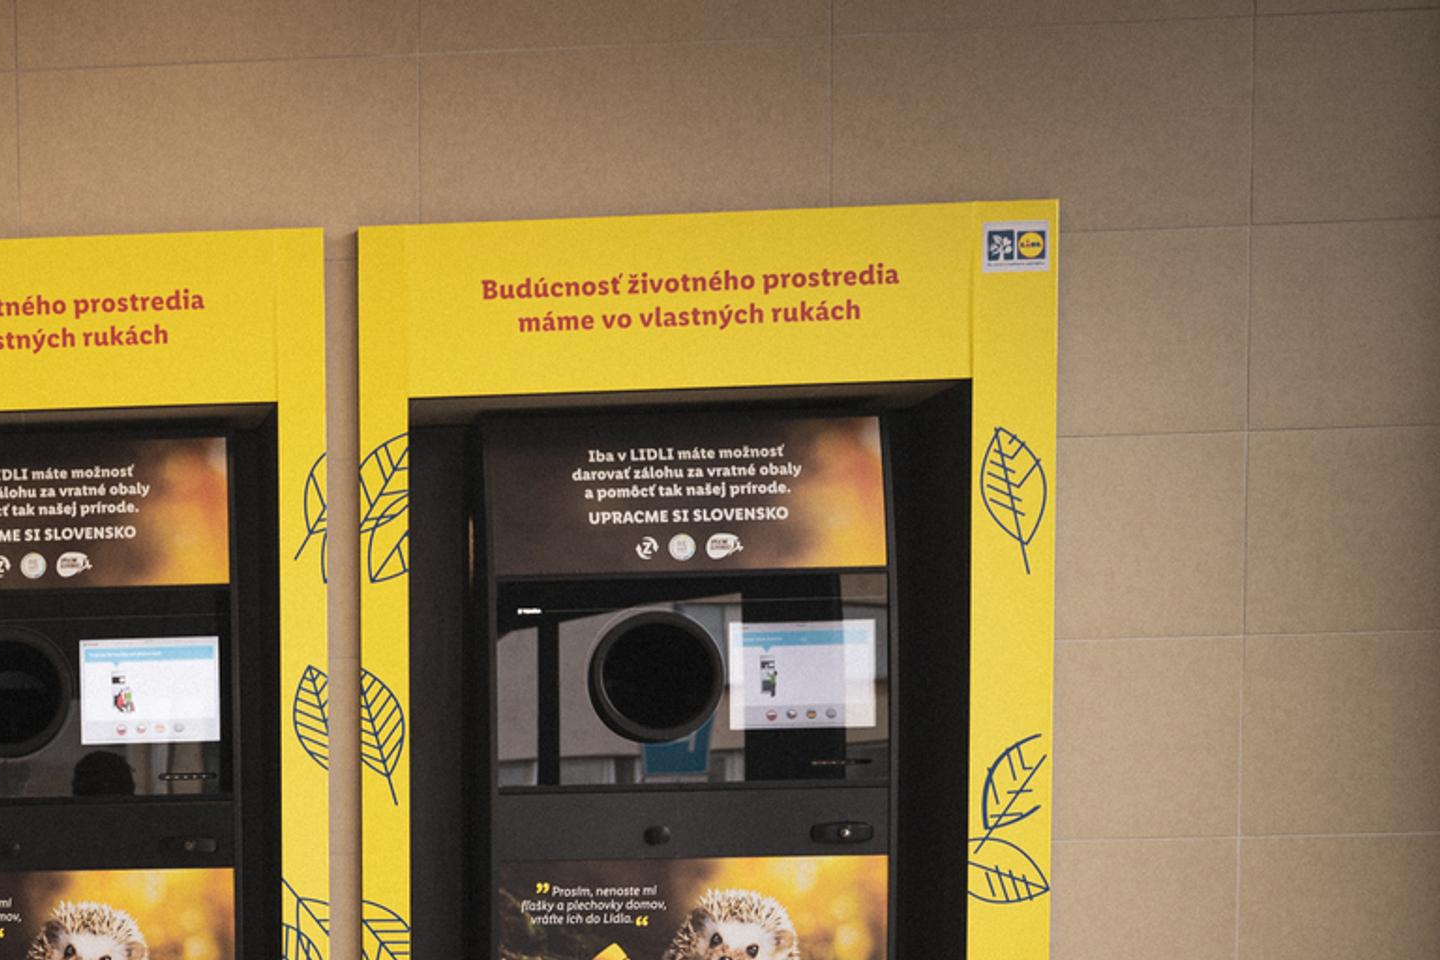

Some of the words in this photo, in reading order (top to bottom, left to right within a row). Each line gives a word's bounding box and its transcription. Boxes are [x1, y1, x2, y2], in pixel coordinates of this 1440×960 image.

[481, 273, 623, 300] Budúcnosť
[628, 270, 755, 295] životného
[763, 262, 900, 295] prostredia
[73, 288, 205, 320] prostredia
[518, 311, 594, 333] máme
[602, 313, 632, 329] vo
[640, 303, 764, 330] vlastných
[772, 299, 860, 323] rukách
[83, 323, 168, 347] rukách
[588, 450, 614, 463] Iba
[618, 453, 628, 462] v
[629, 448, 674, 461] LIDLI
[677, 446, 715, 460] máte
[719, 444, 785, 459] možnosť
[31, 467, 68, 480] máte
[71, 464, 135, 479] možnosť
[572, 466, 631, 481] darovať
[633, 465, 683, 479] zálohu
[687, 468, 704, 478] za
[707, 464, 756, 477] vratné
[759, 462, 802, 478] obaly
[39, 487, 56, 498] za
[59, 484, 106, 497] vratné
[109, 482, 150, 498] obaly
[584, 489, 594, 499] a
[596, 484, 656, 501] pomôcť
[659, 484, 683, 497] tak
[686, 482, 726, 498] našej
[729, 481, 791, 498] prírode.
[12, 503, 35, 516] tak
[38, 502, 77, 518] našej
[80, 500, 139, 518] prírode.
[588, 510, 669, 525] UPRACME
[672, 509, 689, 522] SI
[693, 506, 789, 522] SLOVENSKO
[24, 529, 40, 542] SI
[44, 525, 137, 541] SLOVENSKO
[596, 885, 640, 897] nenoste
[642, 885, 658, 895] mi
[556, 903, 564, 911] a
[566, 899, 624, 912] plechovky
[625, 899, 667, 911] domov,
[566, 913, 583, 925] ich
[585, 913, 601, 924] do
